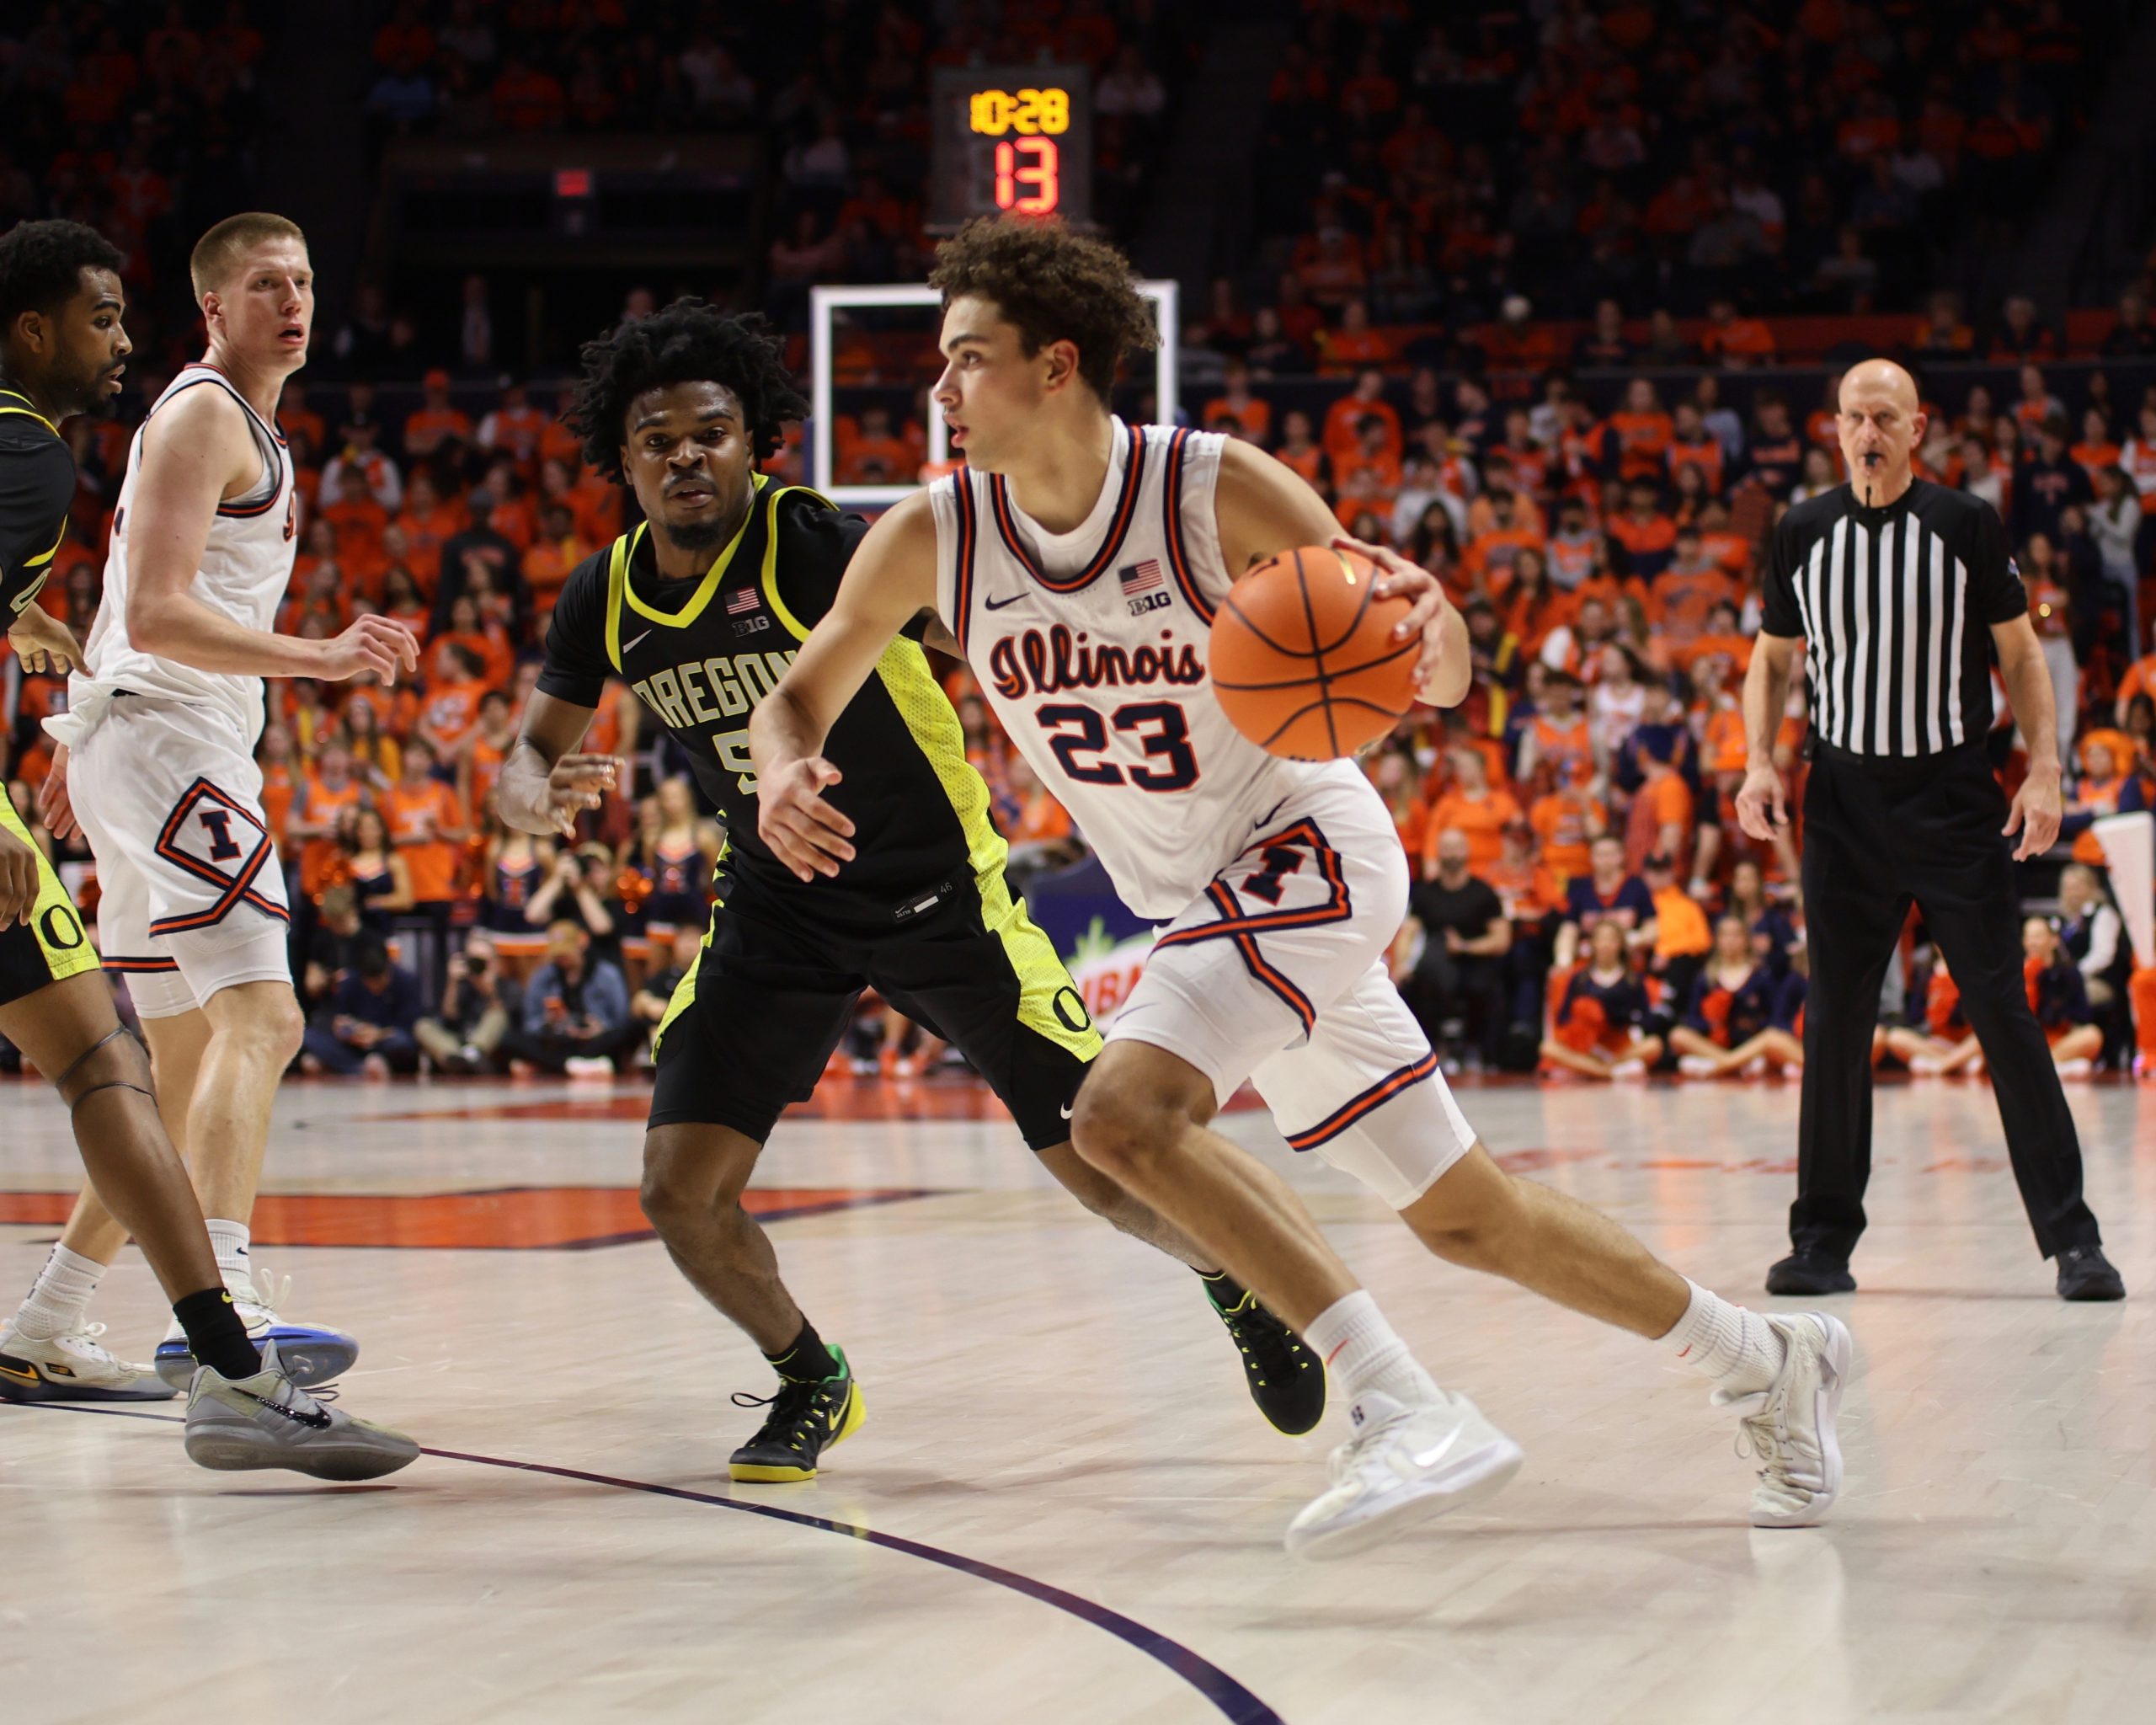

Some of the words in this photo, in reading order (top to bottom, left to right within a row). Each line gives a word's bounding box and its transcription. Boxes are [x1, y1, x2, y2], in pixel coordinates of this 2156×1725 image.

[970, 88, 1070, 136] 10:28
[995, 136, 1059, 214] 13
[990, 623, 1206, 700] Illinois
[1034, 700, 1200, 793] 23
